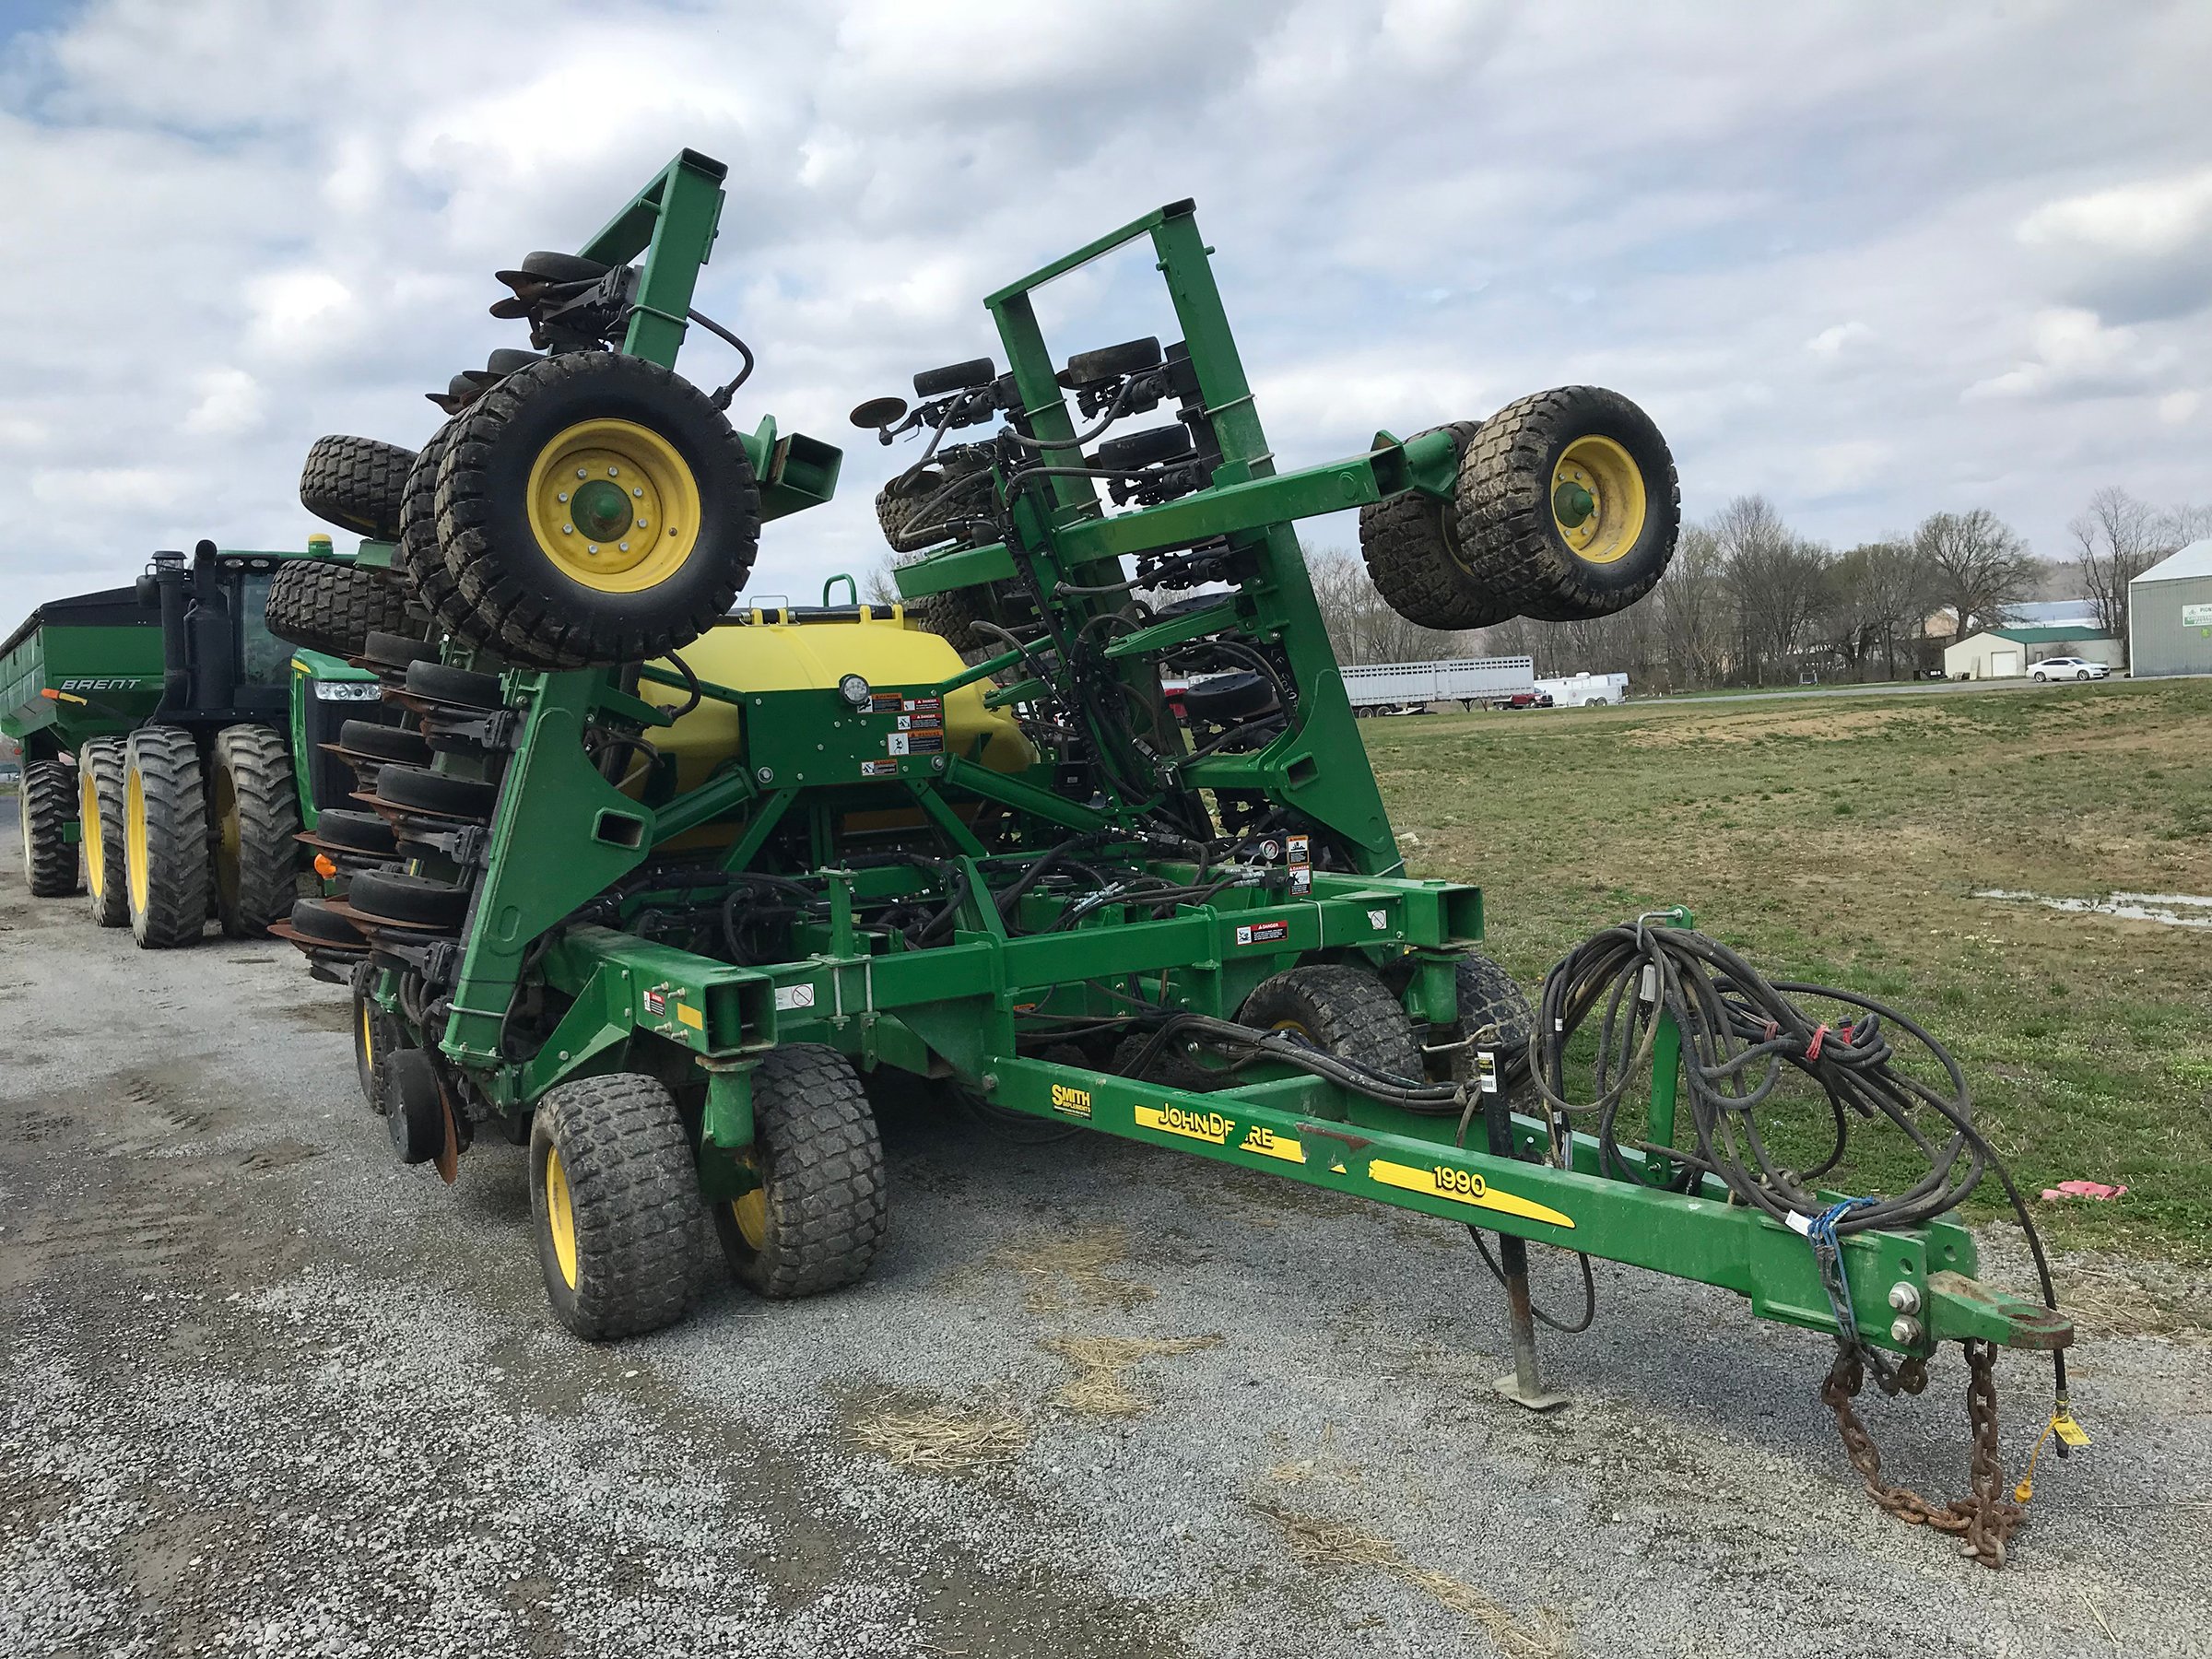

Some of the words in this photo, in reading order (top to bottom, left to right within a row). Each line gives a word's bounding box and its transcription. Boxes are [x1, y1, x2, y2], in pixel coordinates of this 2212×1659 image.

[60, 678, 142, 690] BRENT
[1052, 1083, 1091, 1107] SMITH
[1159, 1103, 1208, 1135] JOHN
[1433, 1165, 1487, 1198] 1990
